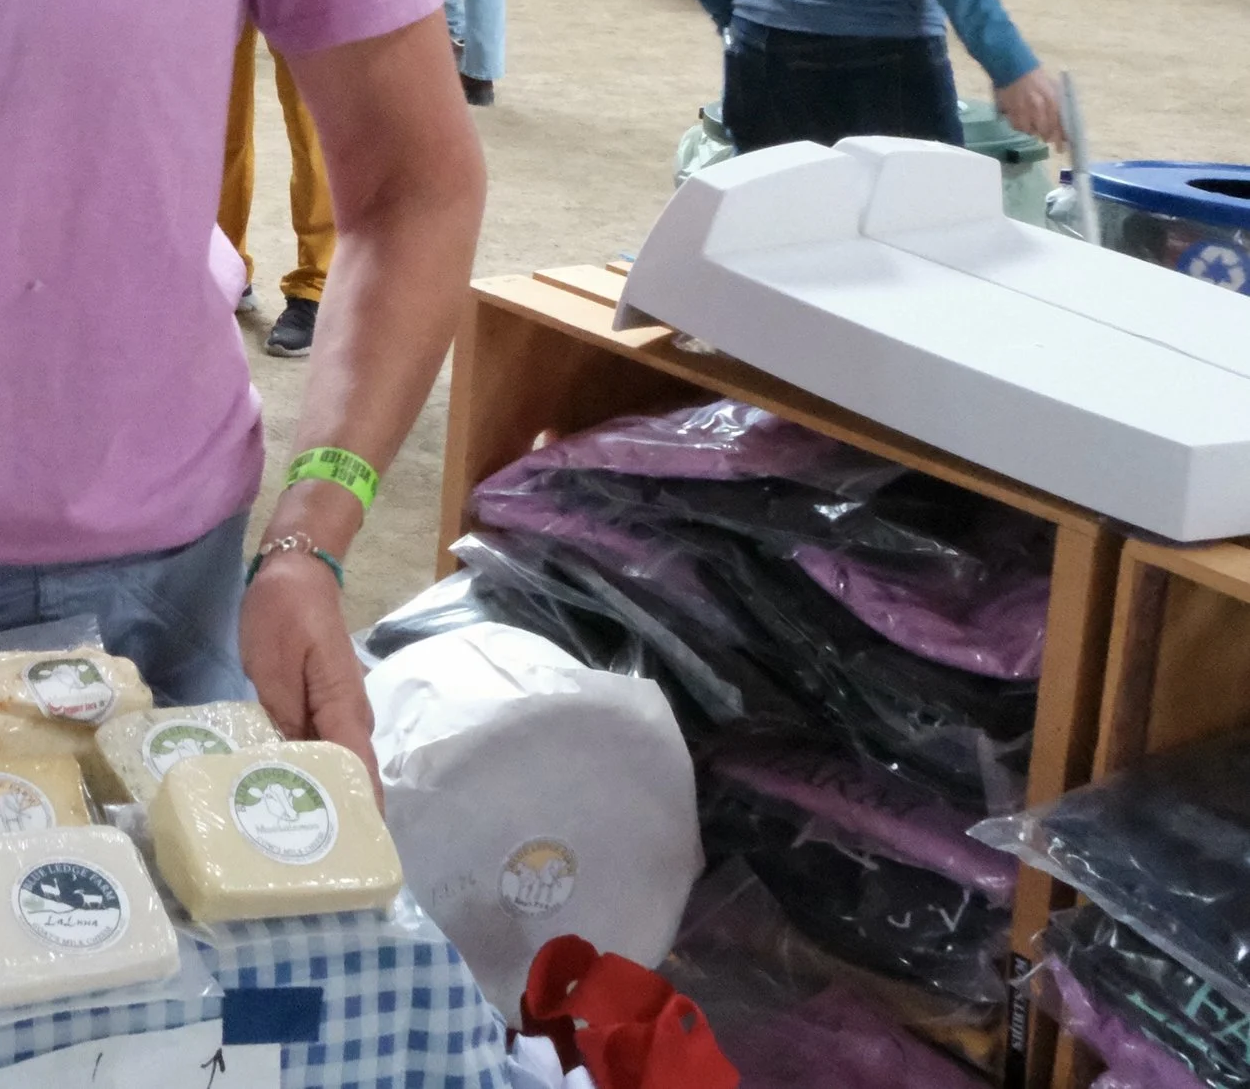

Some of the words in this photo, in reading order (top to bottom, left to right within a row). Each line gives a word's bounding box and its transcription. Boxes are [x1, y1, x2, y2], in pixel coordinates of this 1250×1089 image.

[23, 867, 47, 891] BLUE
[47, 864, 88, 878] LEDGE
[89, 871, 117, 902] FARM
